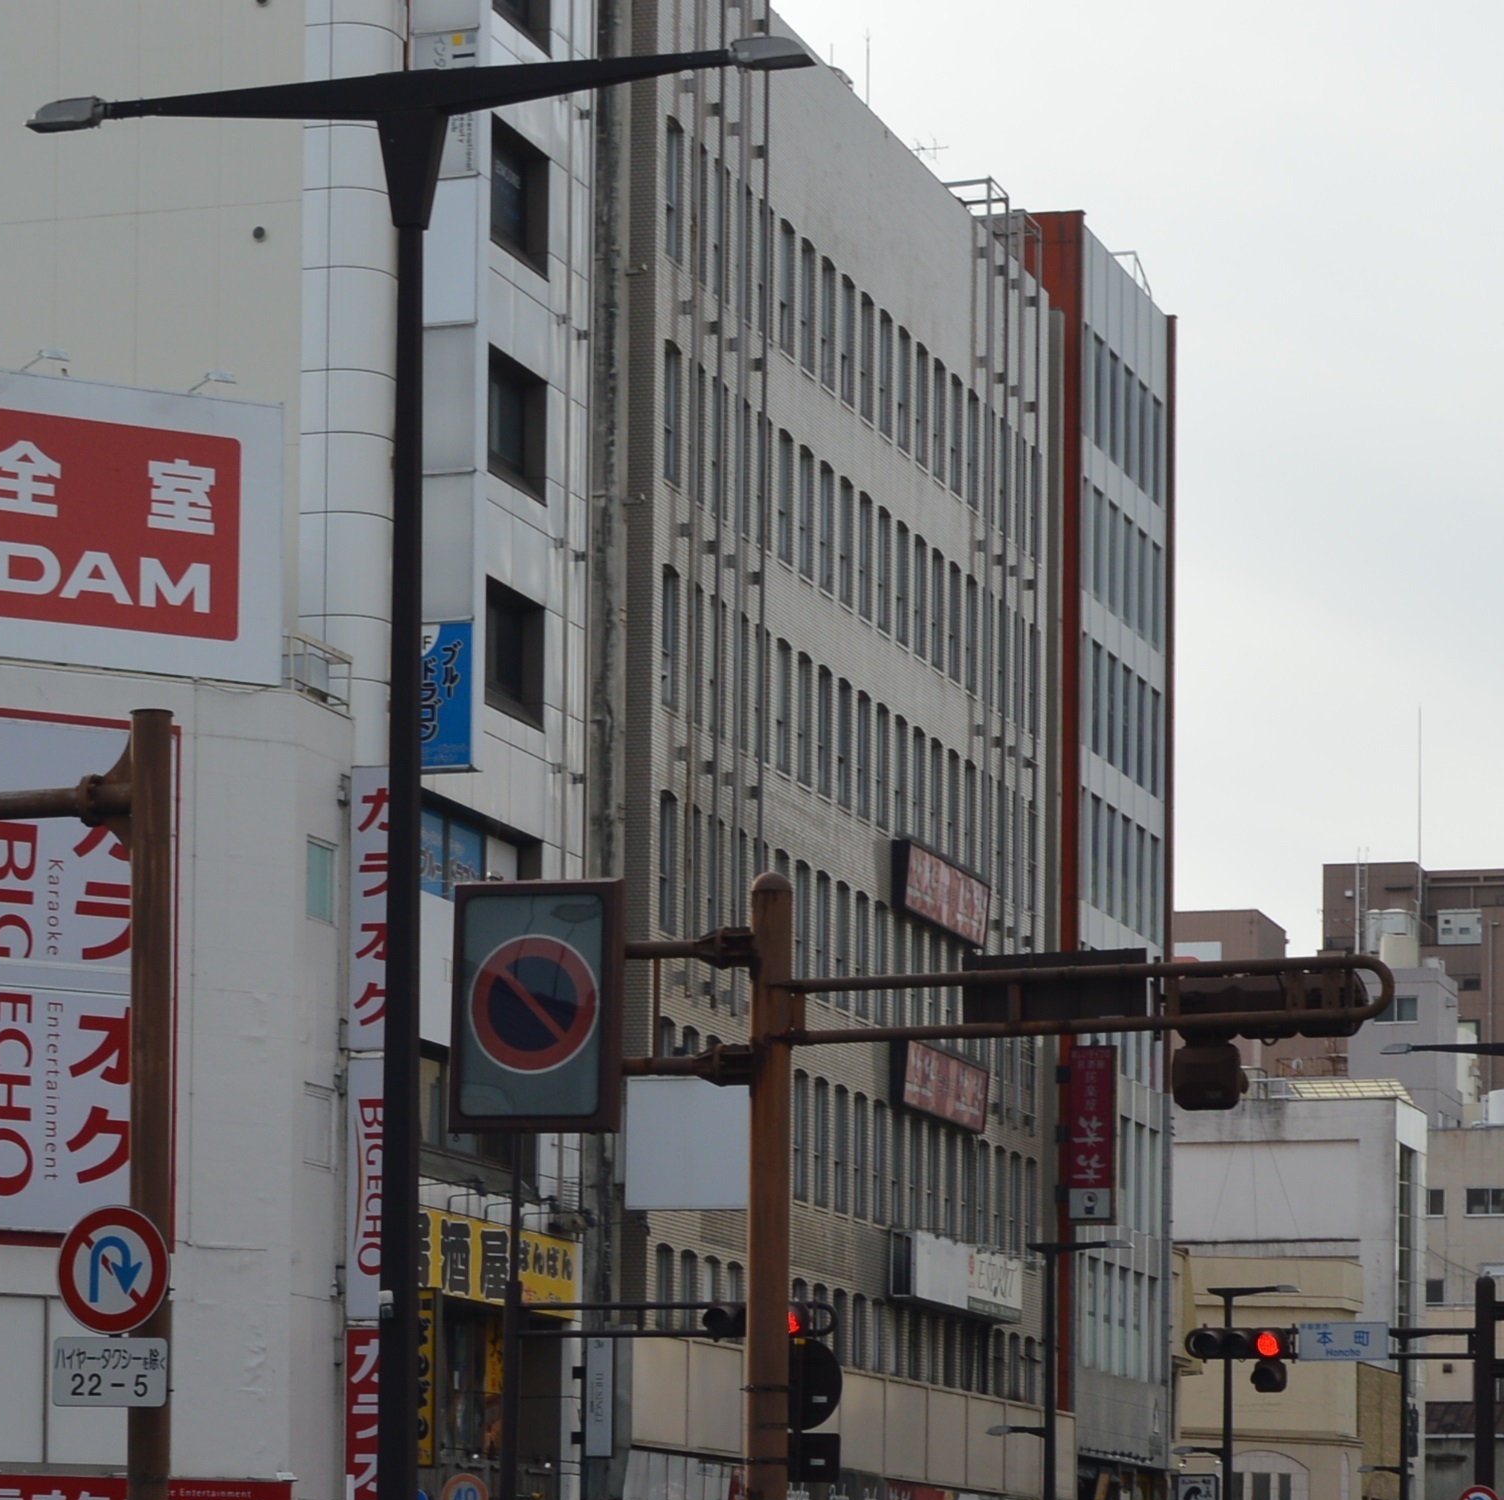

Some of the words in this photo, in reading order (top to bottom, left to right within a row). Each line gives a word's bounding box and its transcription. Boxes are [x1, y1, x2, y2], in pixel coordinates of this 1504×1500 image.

[46, 858, 65, 957] Karaoke
[43, 1001, 64, 1182] Entertainment
[1316, 1330, 1371, 1347] 本町
[178, 1487, 253, 1499] Entertainment
